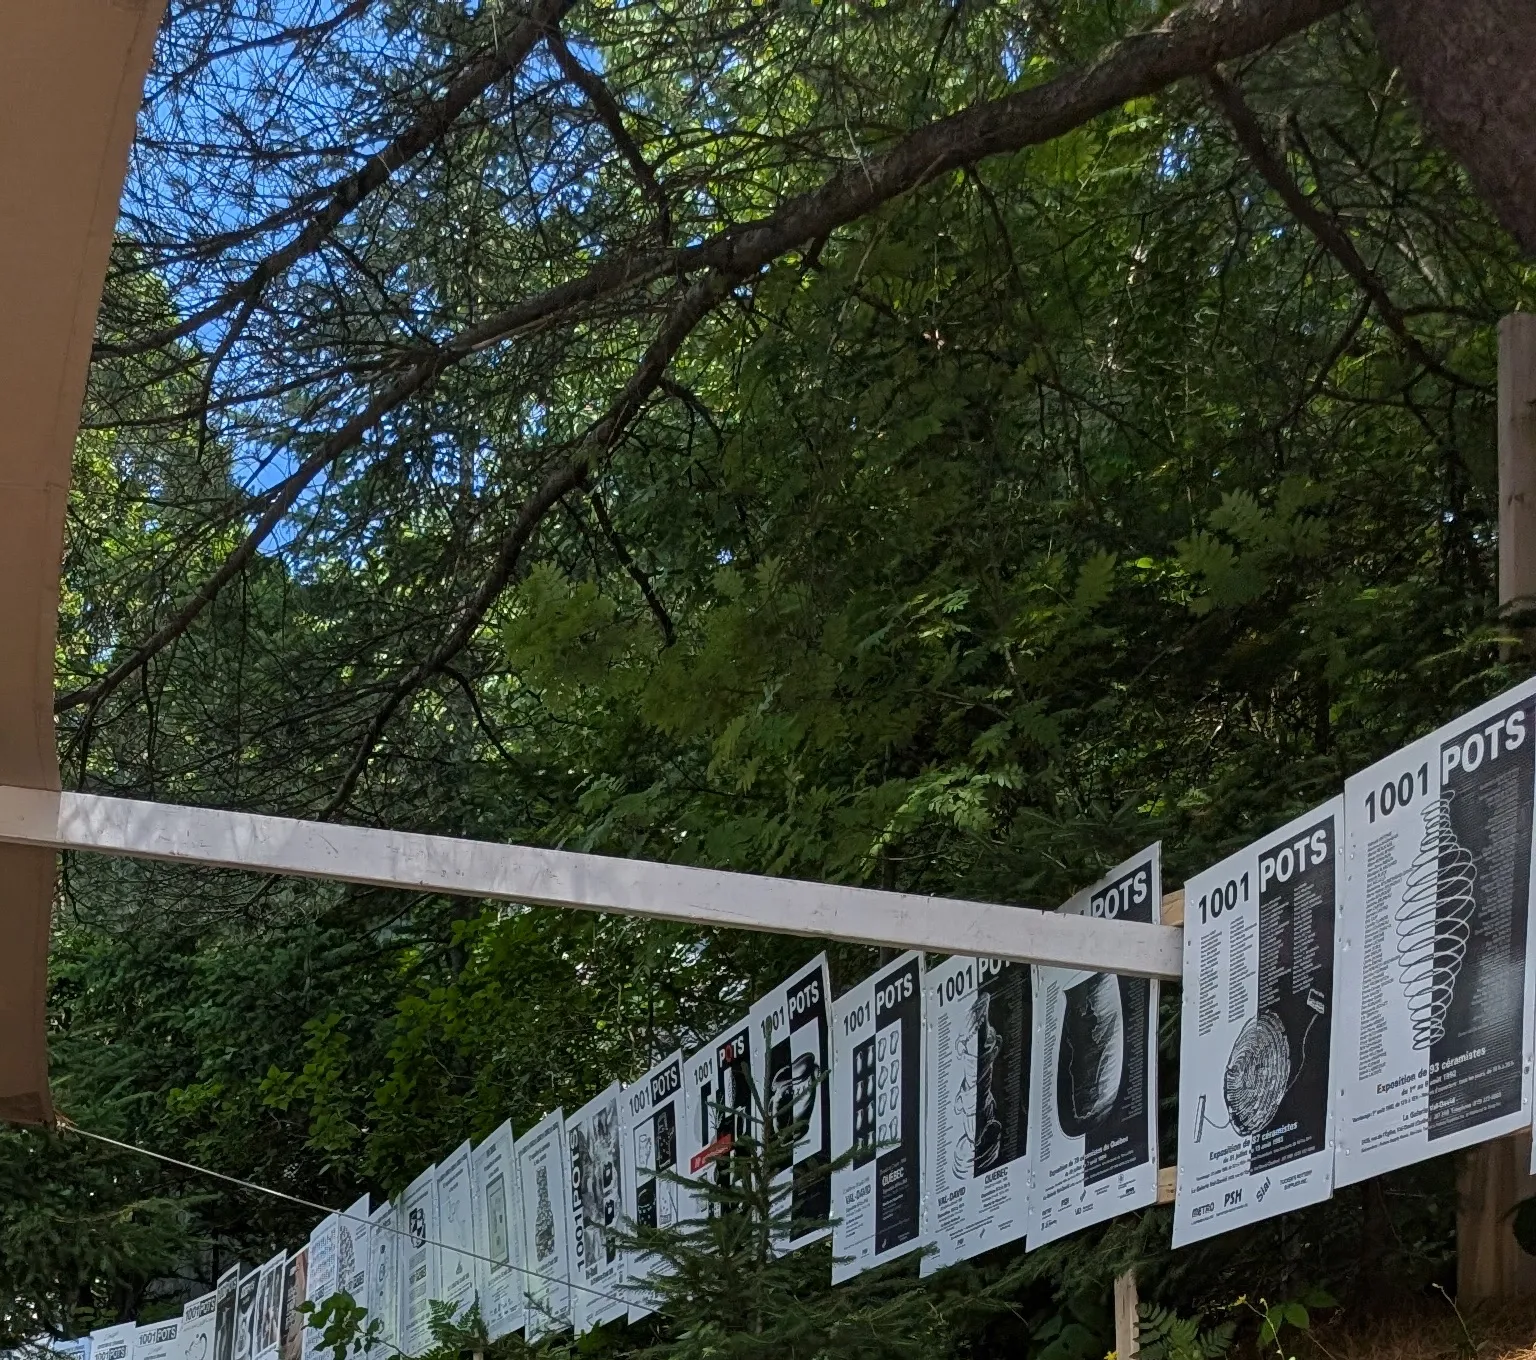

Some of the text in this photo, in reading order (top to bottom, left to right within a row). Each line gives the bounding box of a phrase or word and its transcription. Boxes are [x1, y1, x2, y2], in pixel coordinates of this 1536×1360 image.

[1365, 710, 1526, 824] 1001 POTS
[1093, 871, 1148, 919] POTS
[1198, 829, 1327, 925] 1001 POTS
[789, 980, 820, 1020] POTS
[843, 972, 913, 1037] 1001 POTS
[937, 964, 973, 1008] 1001
[694, 1035, 745, 1086] 1001 POTS
[1376, 1046, 1487, 1094] Exposition de 93 céramistes
[629, 1065, 678, 1118] 1001 POTS
[1209, 1143, 1242, 1161] Exposition
[882, 1166, 906, 1187] QUÉBEC
[937, 1186, 966, 1207] VAL-DAVID
[984, 1166, 1009, 1185] QUÉBEC
[1255, 1176, 1272, 1203] Sial
[569, 1129, 585, 1273] 1001 POTS
[1192, 1202, 1215, 1218] METRO
[1223, 1188, 1243, 1208] PSH
[139, 1326, 177, 1346] 1001 POTS
